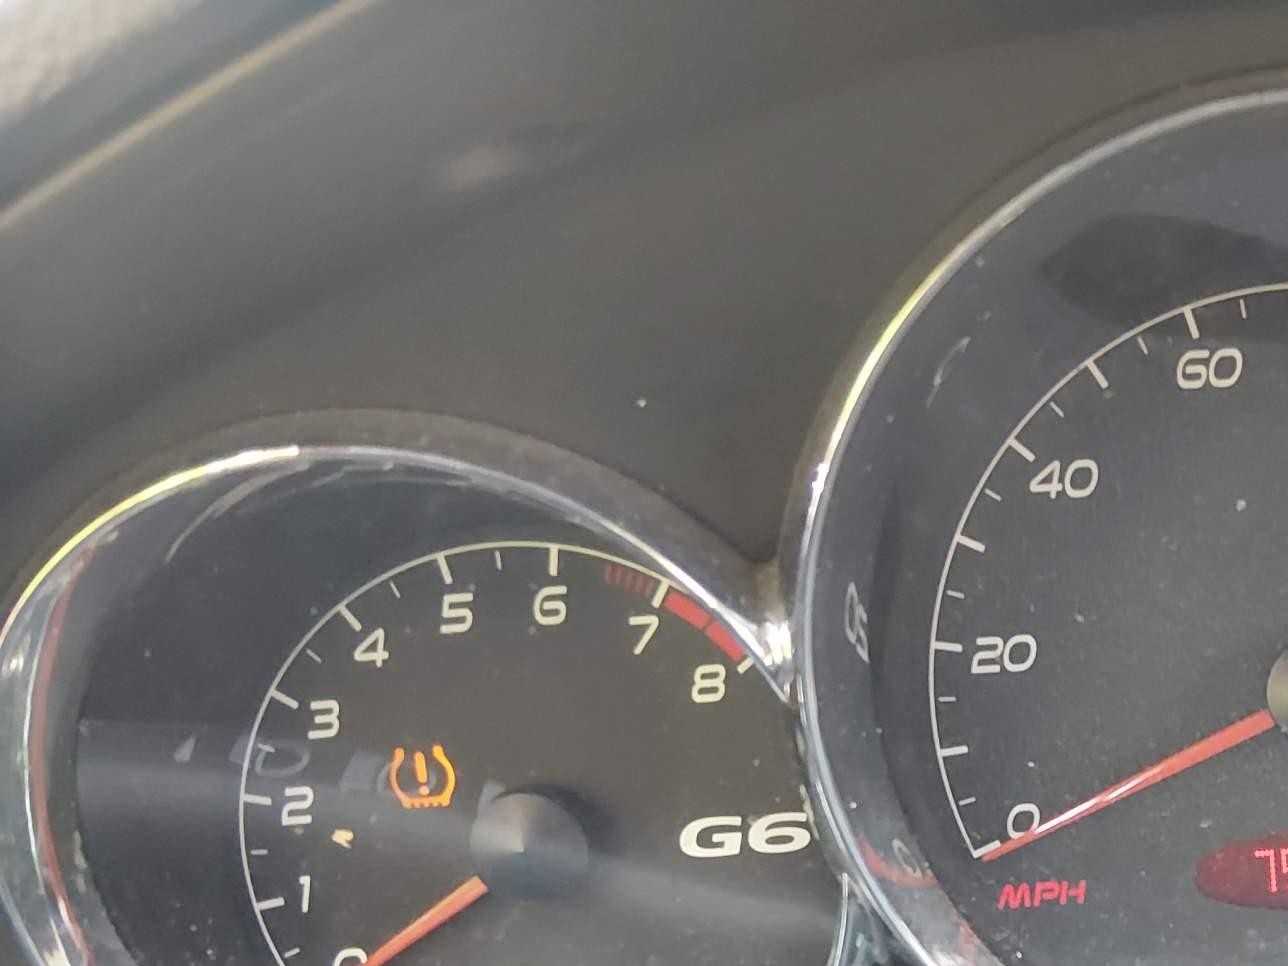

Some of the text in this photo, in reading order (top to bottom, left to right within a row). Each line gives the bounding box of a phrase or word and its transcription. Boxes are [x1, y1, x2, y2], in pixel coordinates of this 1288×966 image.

[1175, 346, 1244, 390] 60
[1029, 457, 1099, 500] 40
[439, 592, 475, 635] 5
[532, 585, 568, 626] 6
[353, 627, 389, 668] 4
[627, 614, 660, 655] 7
[970, 633, 1038, 675] 20
[690, 663, 727, 704] 8
[307, 699, 341, 740] 3
[280, 785, 315, 826] 2
[1006, 802, 1042, 840] 0
[678, 810, 812, 859] G6
[298, 875, 312, 913] 1
[997, 879, 1087, 910] MPH
